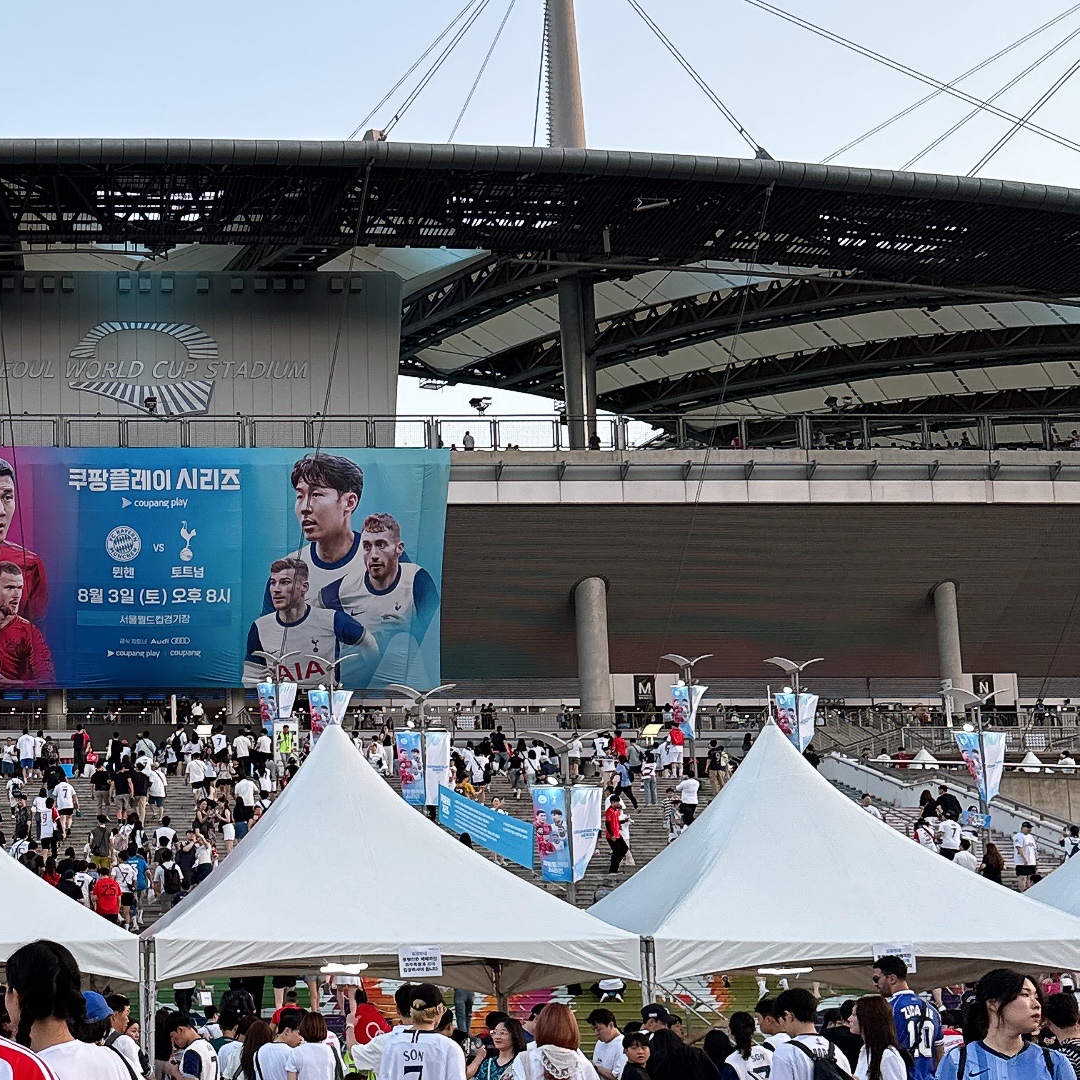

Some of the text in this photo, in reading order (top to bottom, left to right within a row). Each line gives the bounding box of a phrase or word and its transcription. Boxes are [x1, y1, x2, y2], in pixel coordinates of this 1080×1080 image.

[64, 359, 144, 379] WORLD
[151, 359, 197, 378] CUP
[207, 359, 309, 380] STADIUM
[68, 467, 241, 492] 쿠팡플레이 시리즈
[134, 497, 189, 509] coupang play
[112, 566, 204, 579] 뮌헨 토트넘
[77, 588, 231, 606] 8월 3일 (토) 오후 8시
[119, 614, 191, 625] 서울월드컵경기장
[150, 637, 170, 645] Audi
[115, 649, 202, 658] coupang play coupang
[638, 681, 652, 694] M
[979, 681, 989, 694] N
[62, 788, 68, 799] 7
[101, 883, 117, 897] 25
[907, 1020, 935, 1058] 10
[403, 1048, 424, 1062] SON
